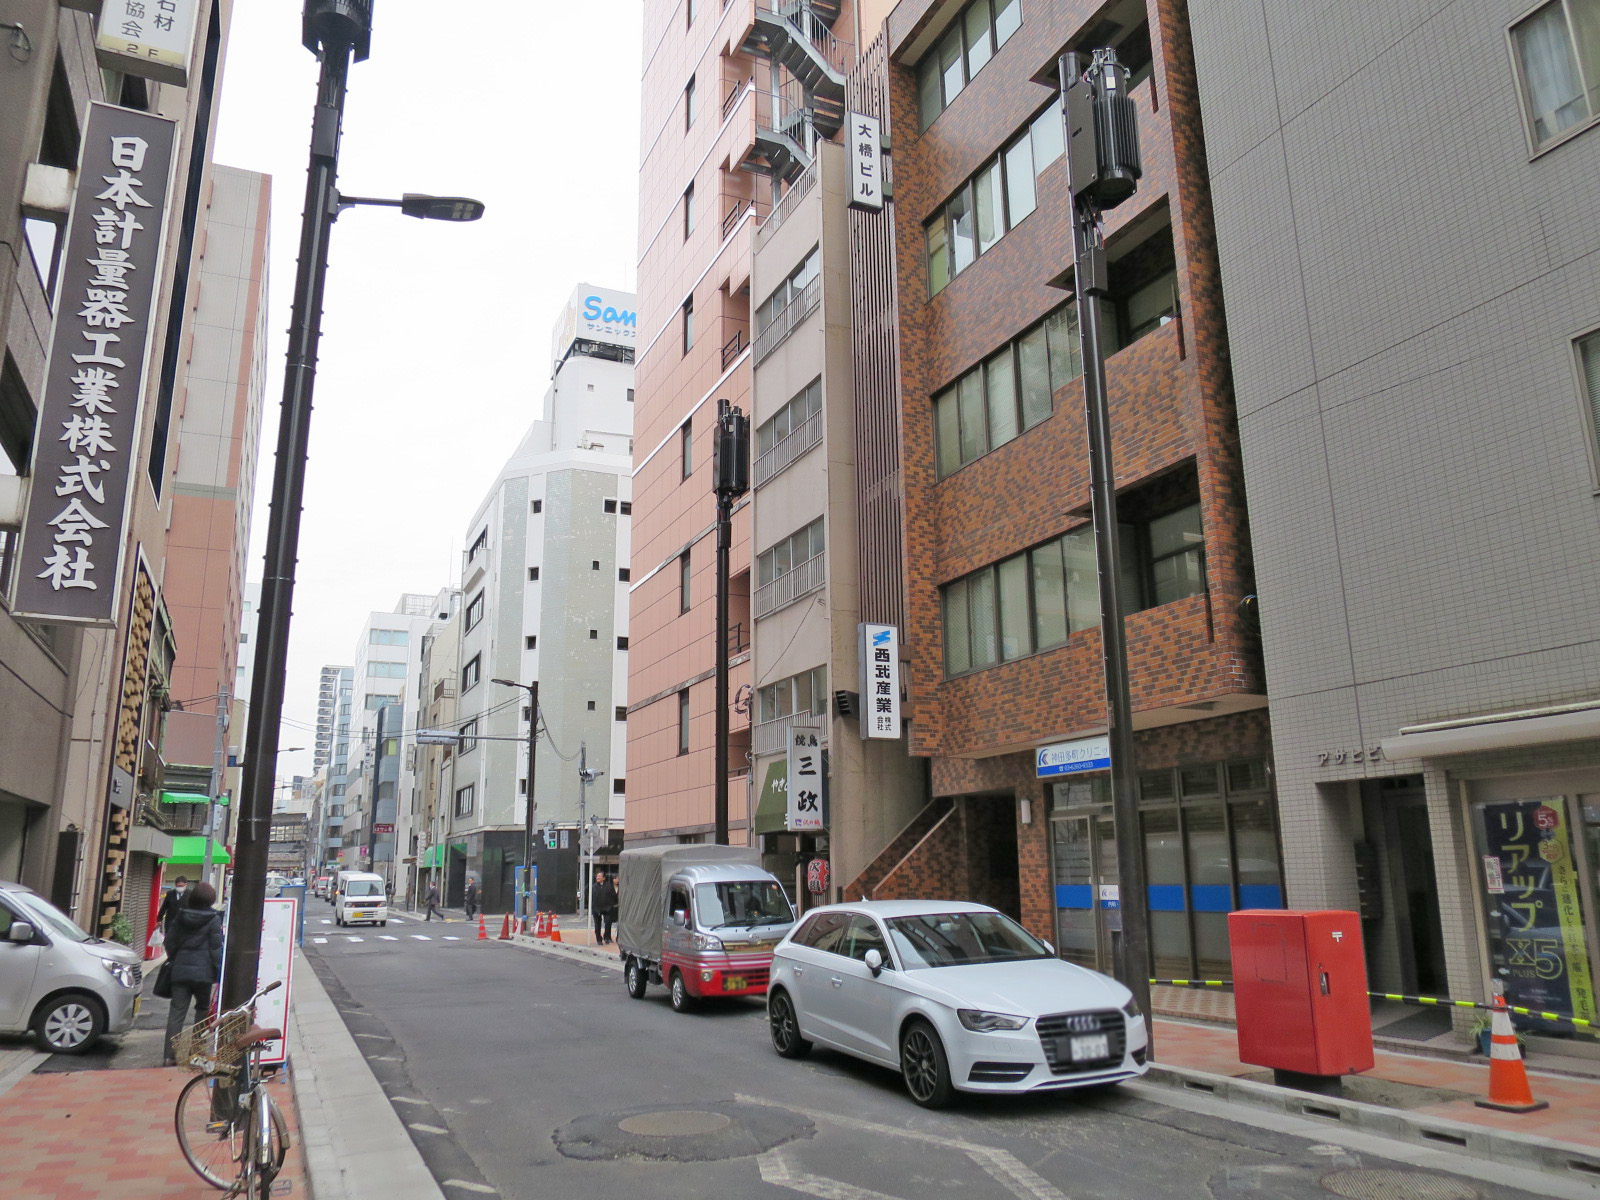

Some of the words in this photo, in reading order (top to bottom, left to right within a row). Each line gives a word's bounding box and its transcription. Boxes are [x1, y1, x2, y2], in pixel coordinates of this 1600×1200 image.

[858, 123, 874, 197] 大橋ビル
[35, 135, 154, 591] 日本計量器工業株式会社
[874, 647, 892, 713] 西武産業
[797, 755, 819, 812] 三政
[1500, 810, 1544, 932] リアップ
[1506, 938, 1563, 980] X5
